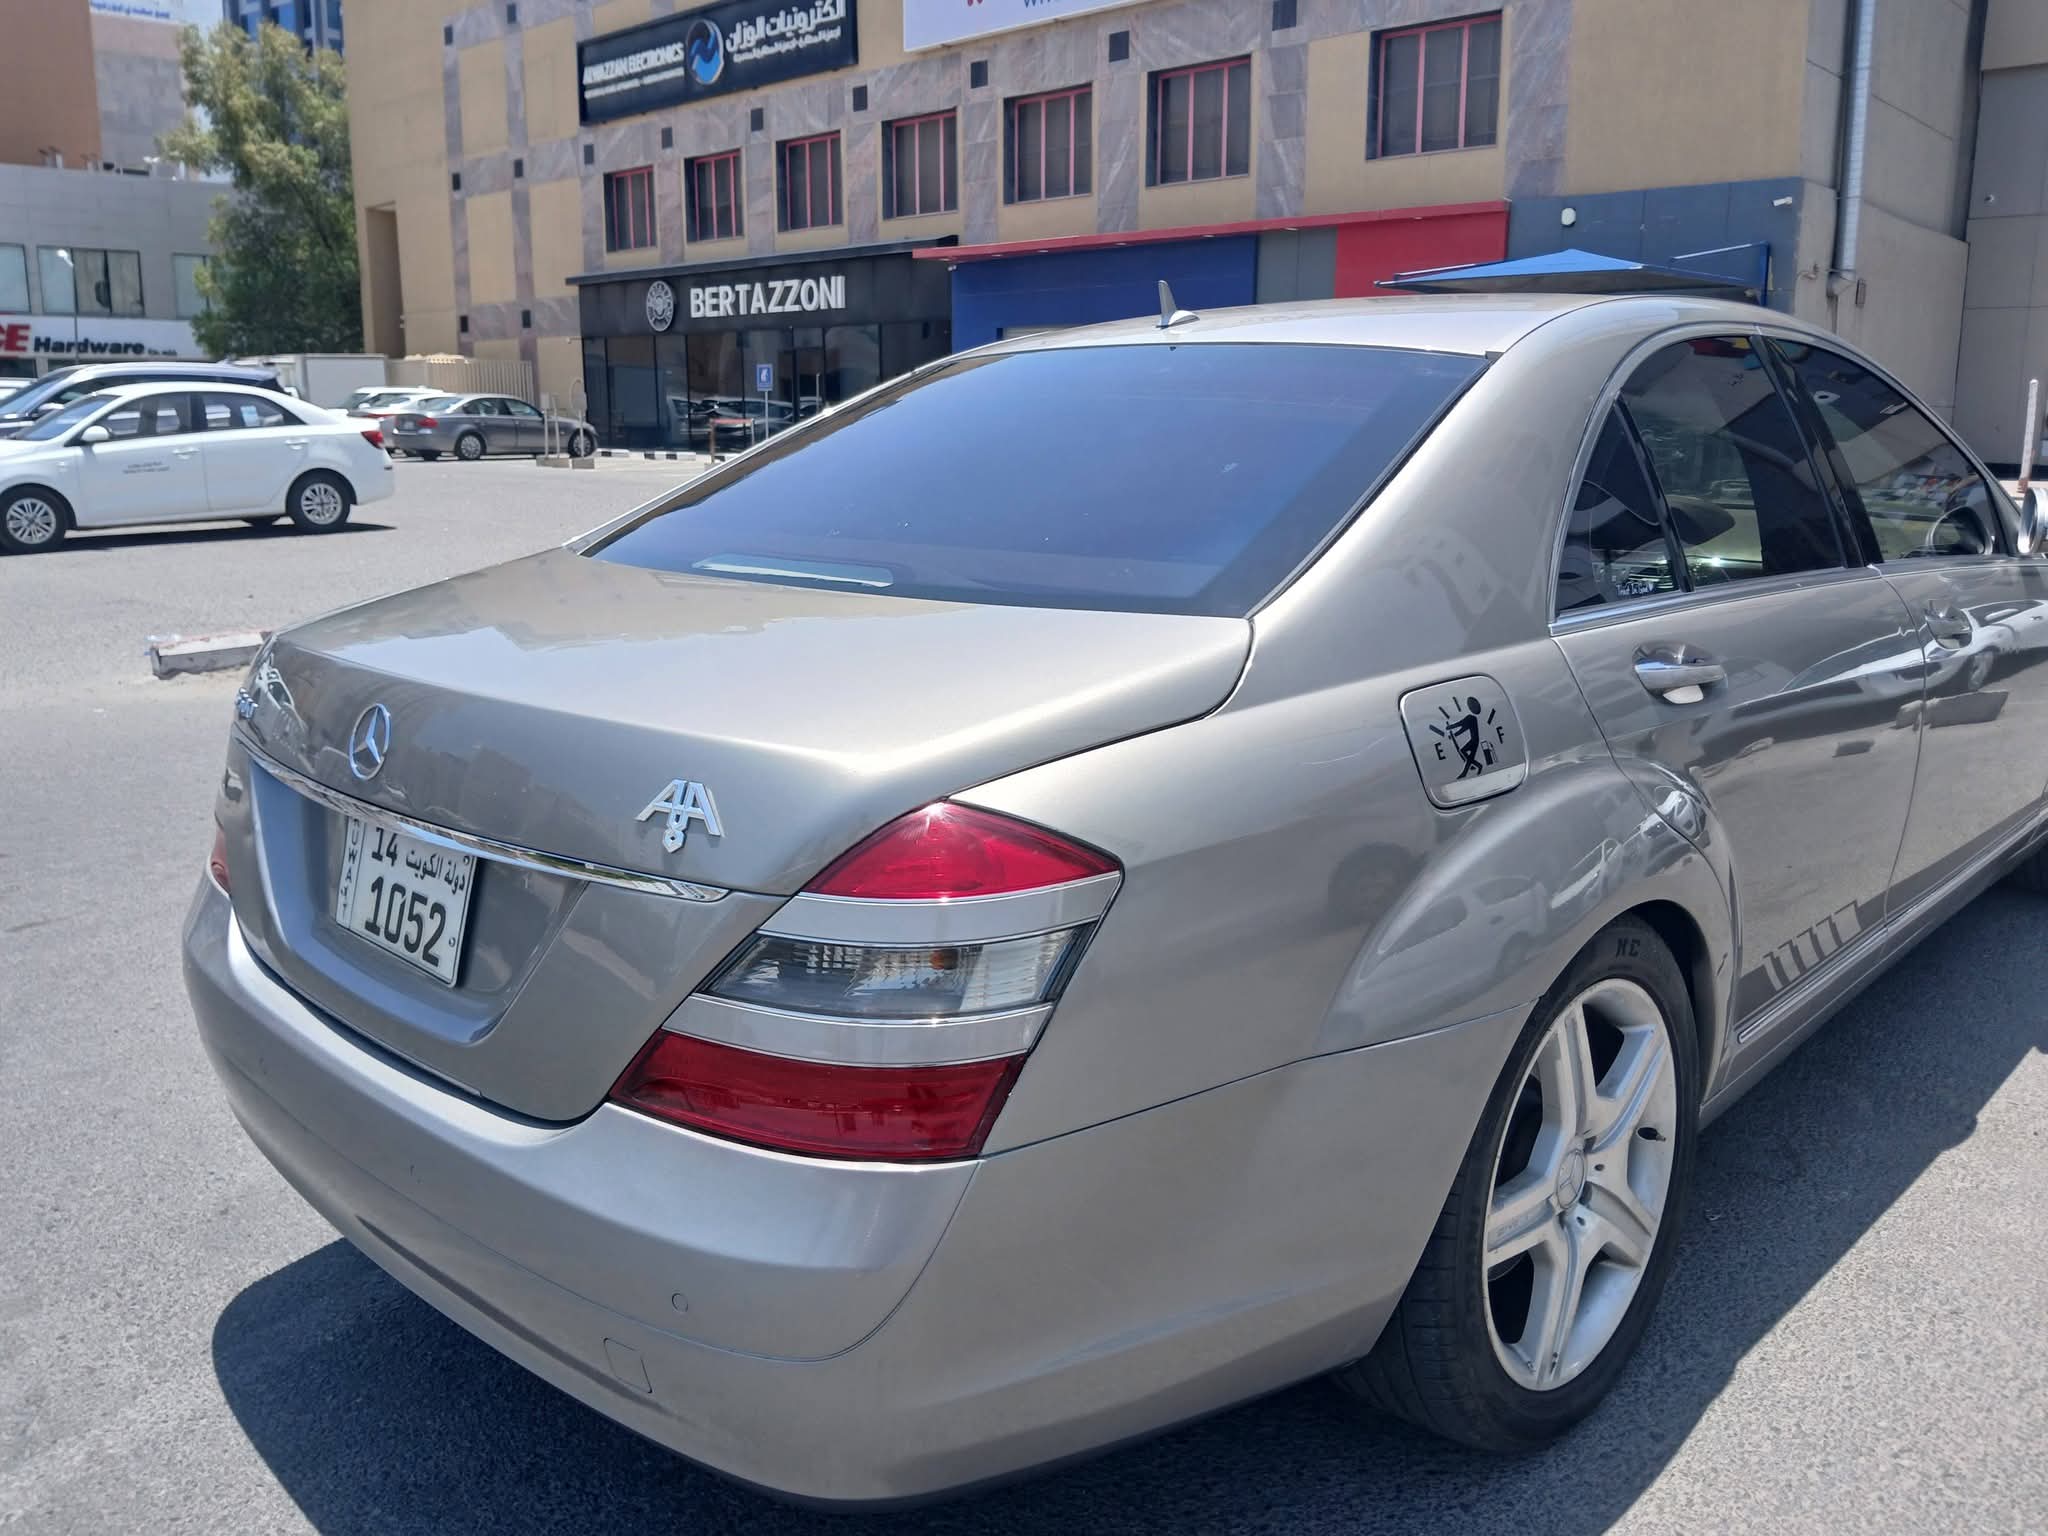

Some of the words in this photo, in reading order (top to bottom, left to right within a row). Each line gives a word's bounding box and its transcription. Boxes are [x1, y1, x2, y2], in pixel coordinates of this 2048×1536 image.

[690, 275, 846, 318] BERTAZZONI
[34, 336, 145, 354] Hardware
[1496, 726, 1505, 744] F
[1434, 742, 1446, 761] E
[371, 826, 398, 867] 14
[405, 850, 444, 881] الكويت
[444, 861, 466, 895] دولة
[364, 875, 447, 968] 1052
